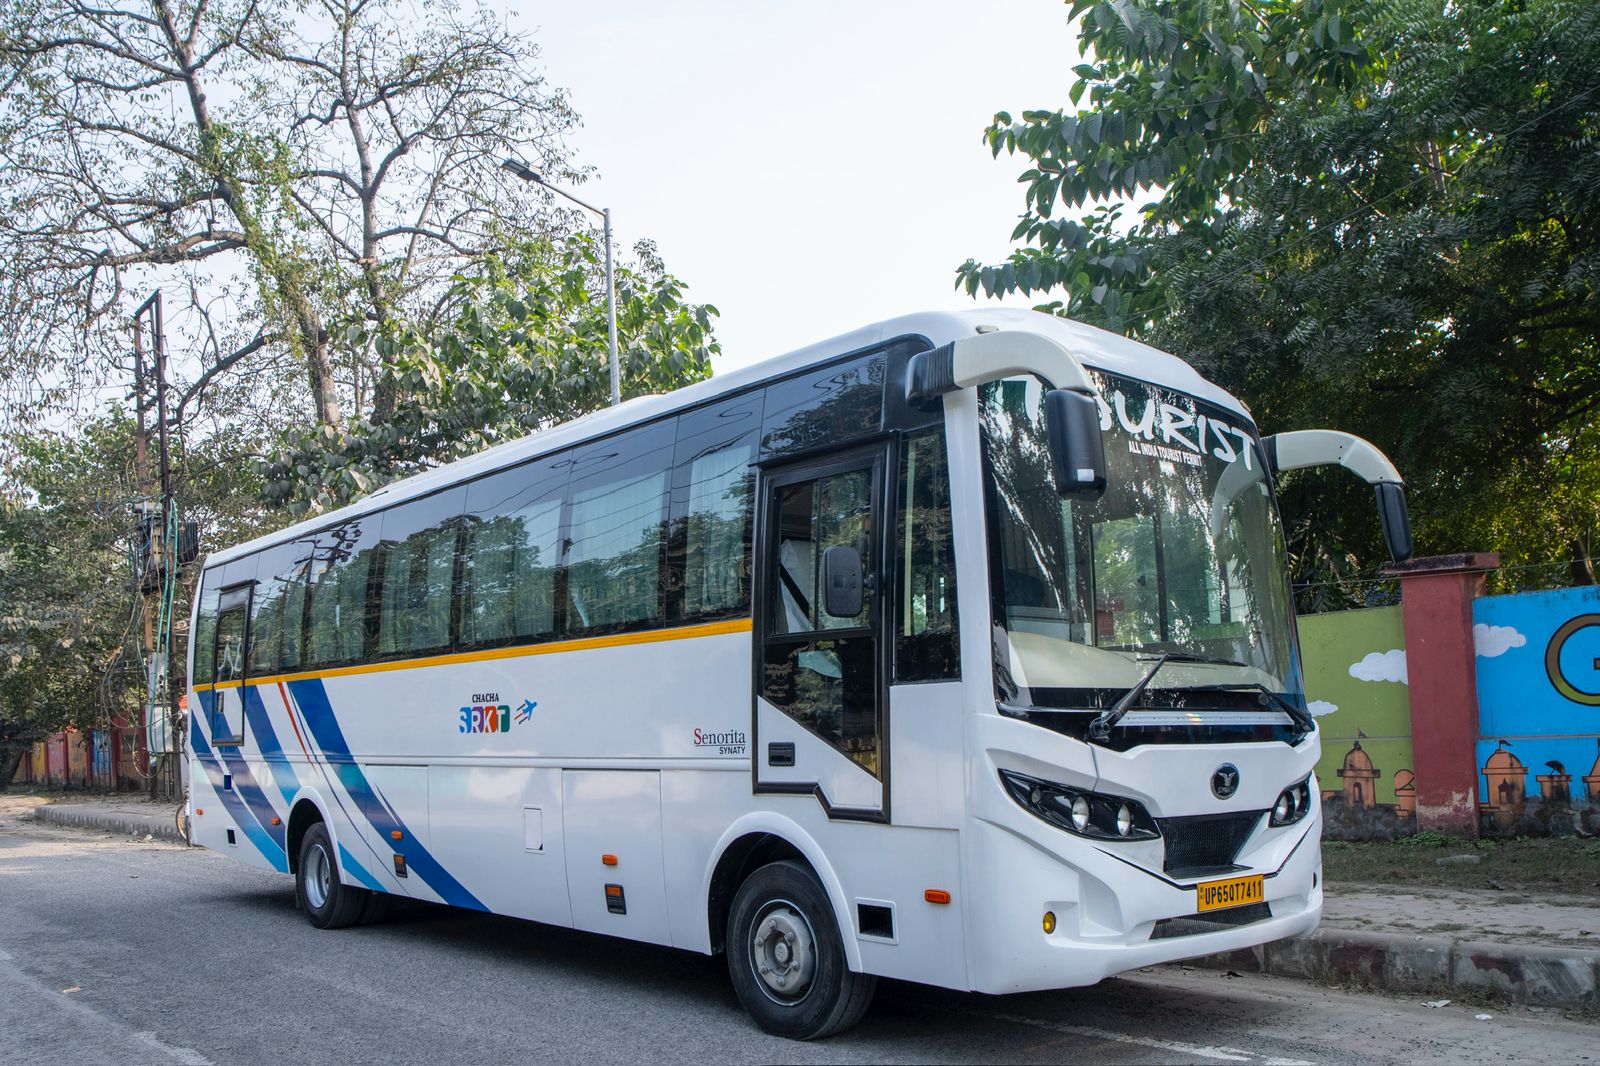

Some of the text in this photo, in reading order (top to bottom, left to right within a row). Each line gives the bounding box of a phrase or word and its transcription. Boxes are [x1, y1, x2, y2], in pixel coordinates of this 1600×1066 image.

[1001, 374, 1254, 471] TURIST
[1128, 440, 1141, 454] ALL
[1140, 443, 1158, 457] INDIA
[472, 693, 499, 703] CHACHA
[459, 705, 510, 733] SRKT
[694, 728, 746, 745] Senorita
[719, 746, 745, 755] SYNATY
[1205, 880, 1261, 905] UP65QT7411
